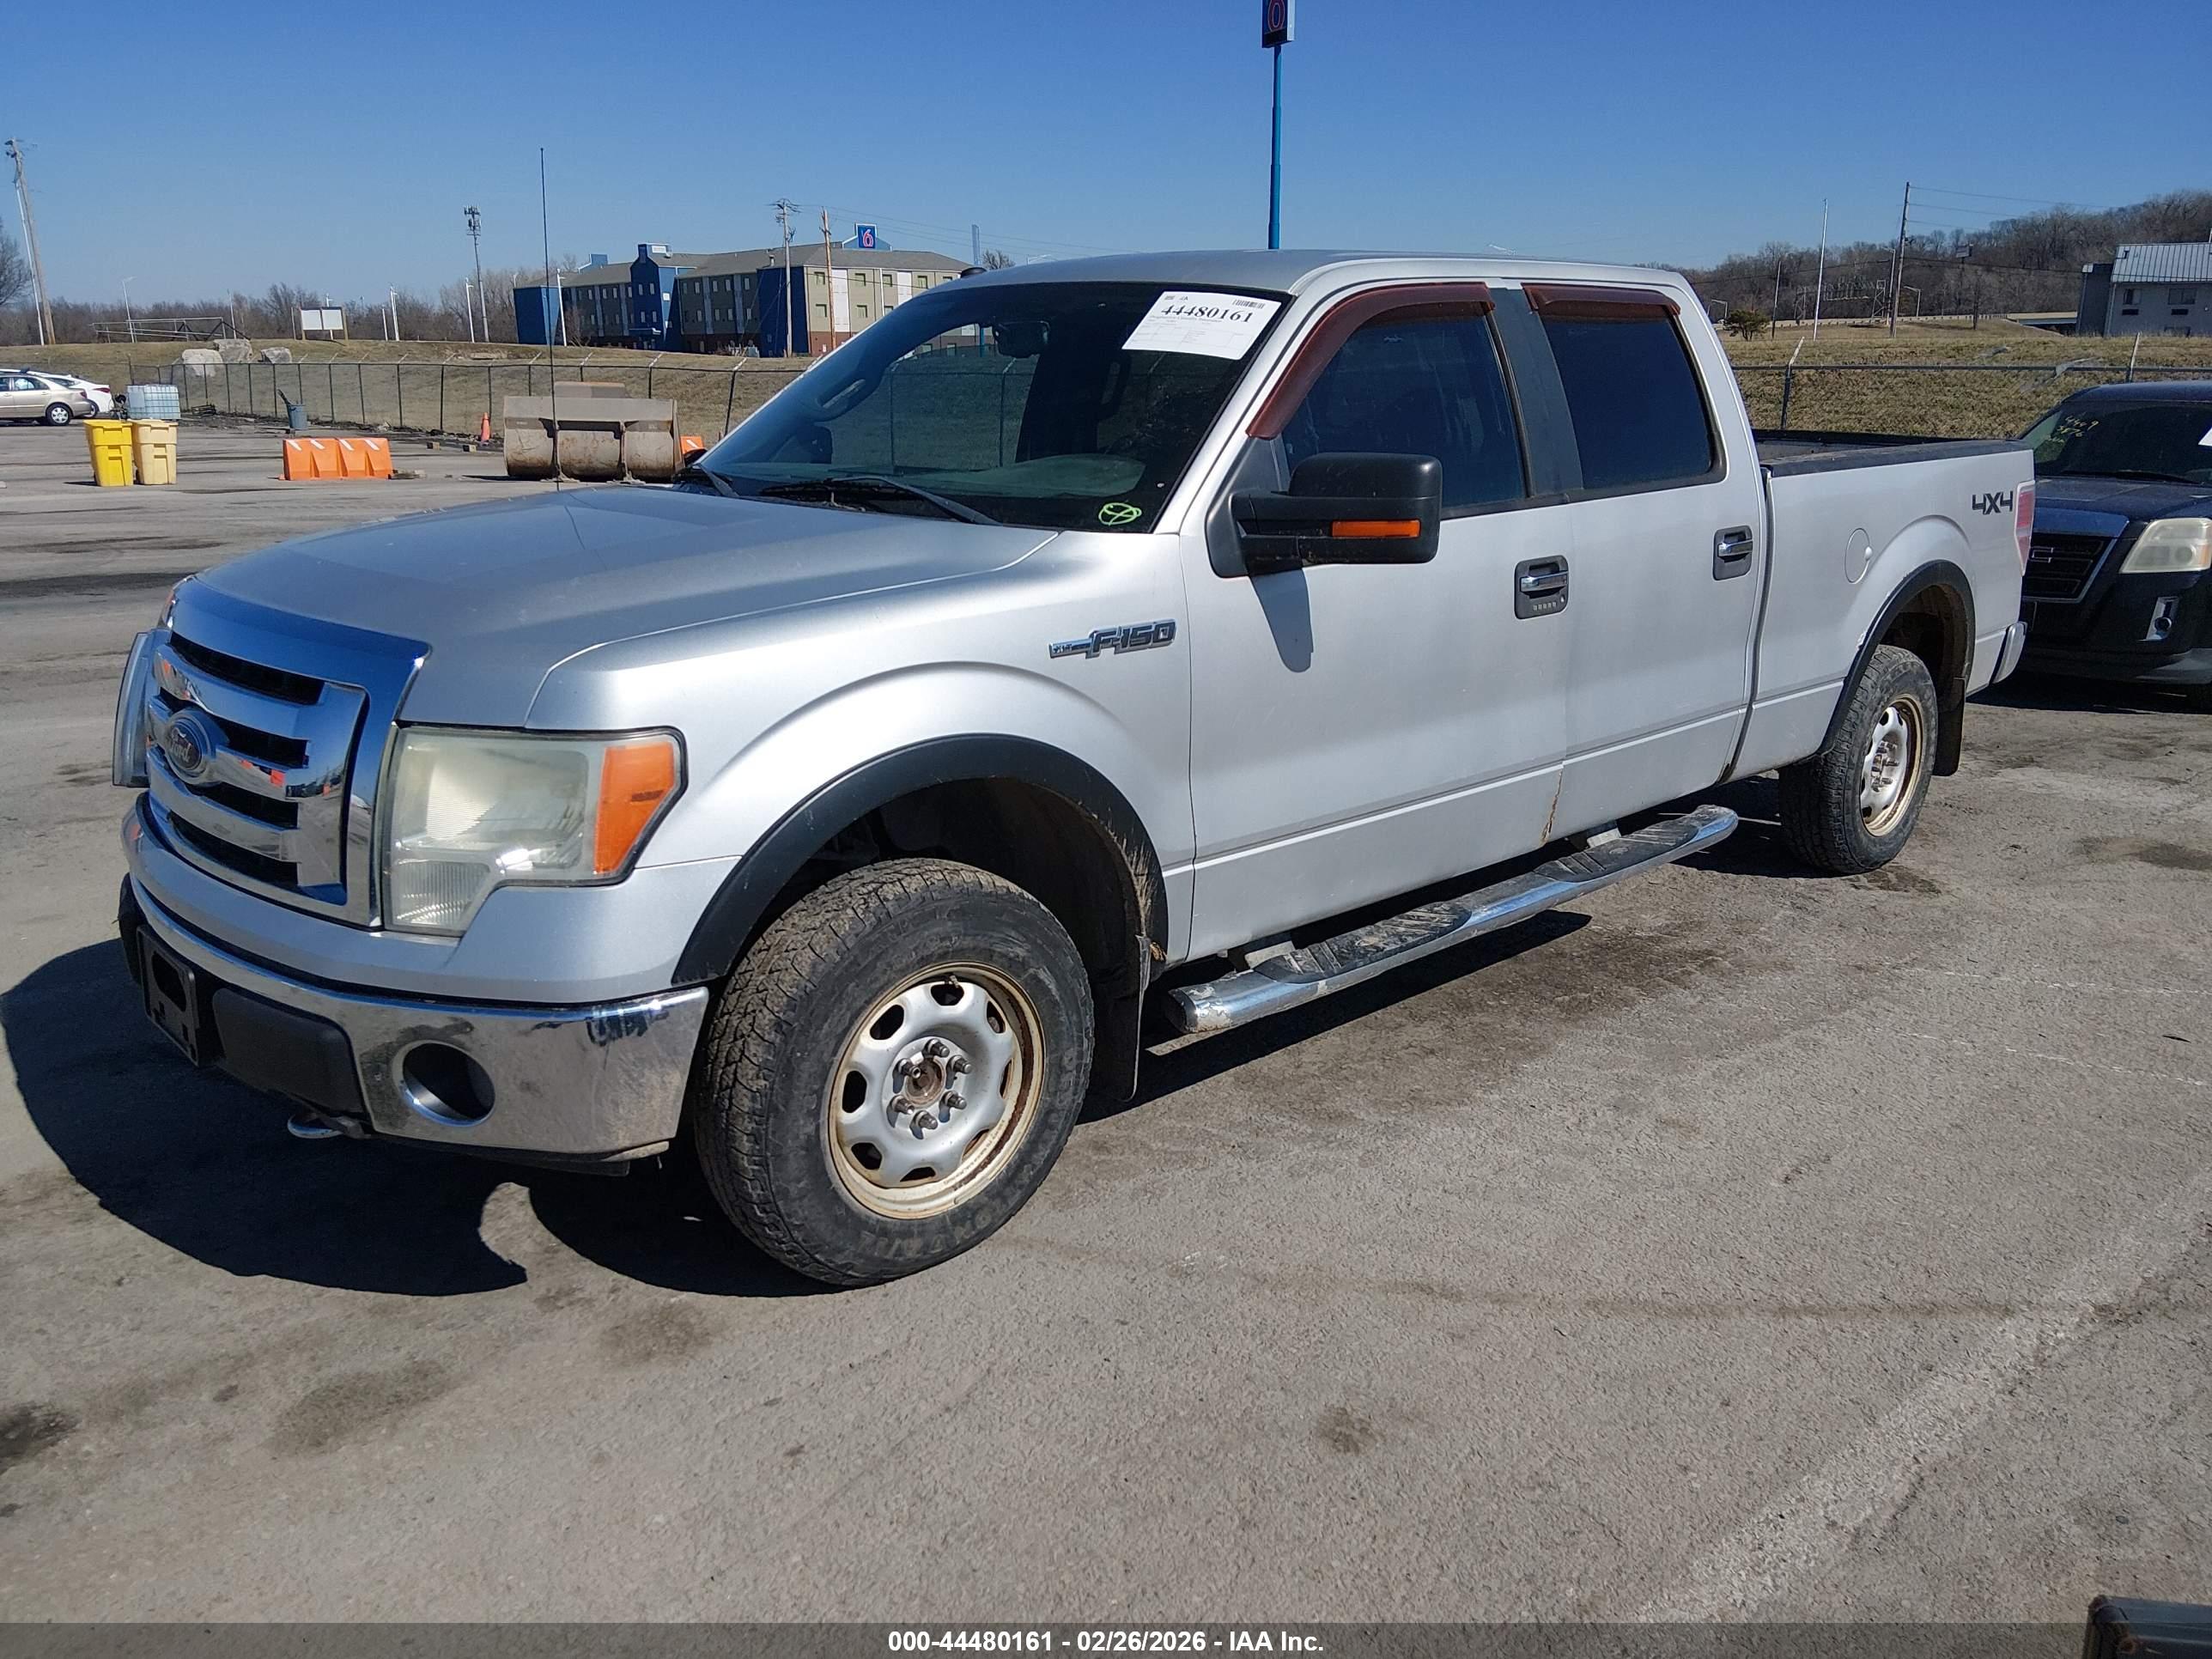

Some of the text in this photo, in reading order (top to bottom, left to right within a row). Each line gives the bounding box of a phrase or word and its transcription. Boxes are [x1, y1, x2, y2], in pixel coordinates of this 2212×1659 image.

[863, 228, 874, 247] 6
[1161, 305, 1255, 323] 44480161
[171, 726, 191, 763] Ford
